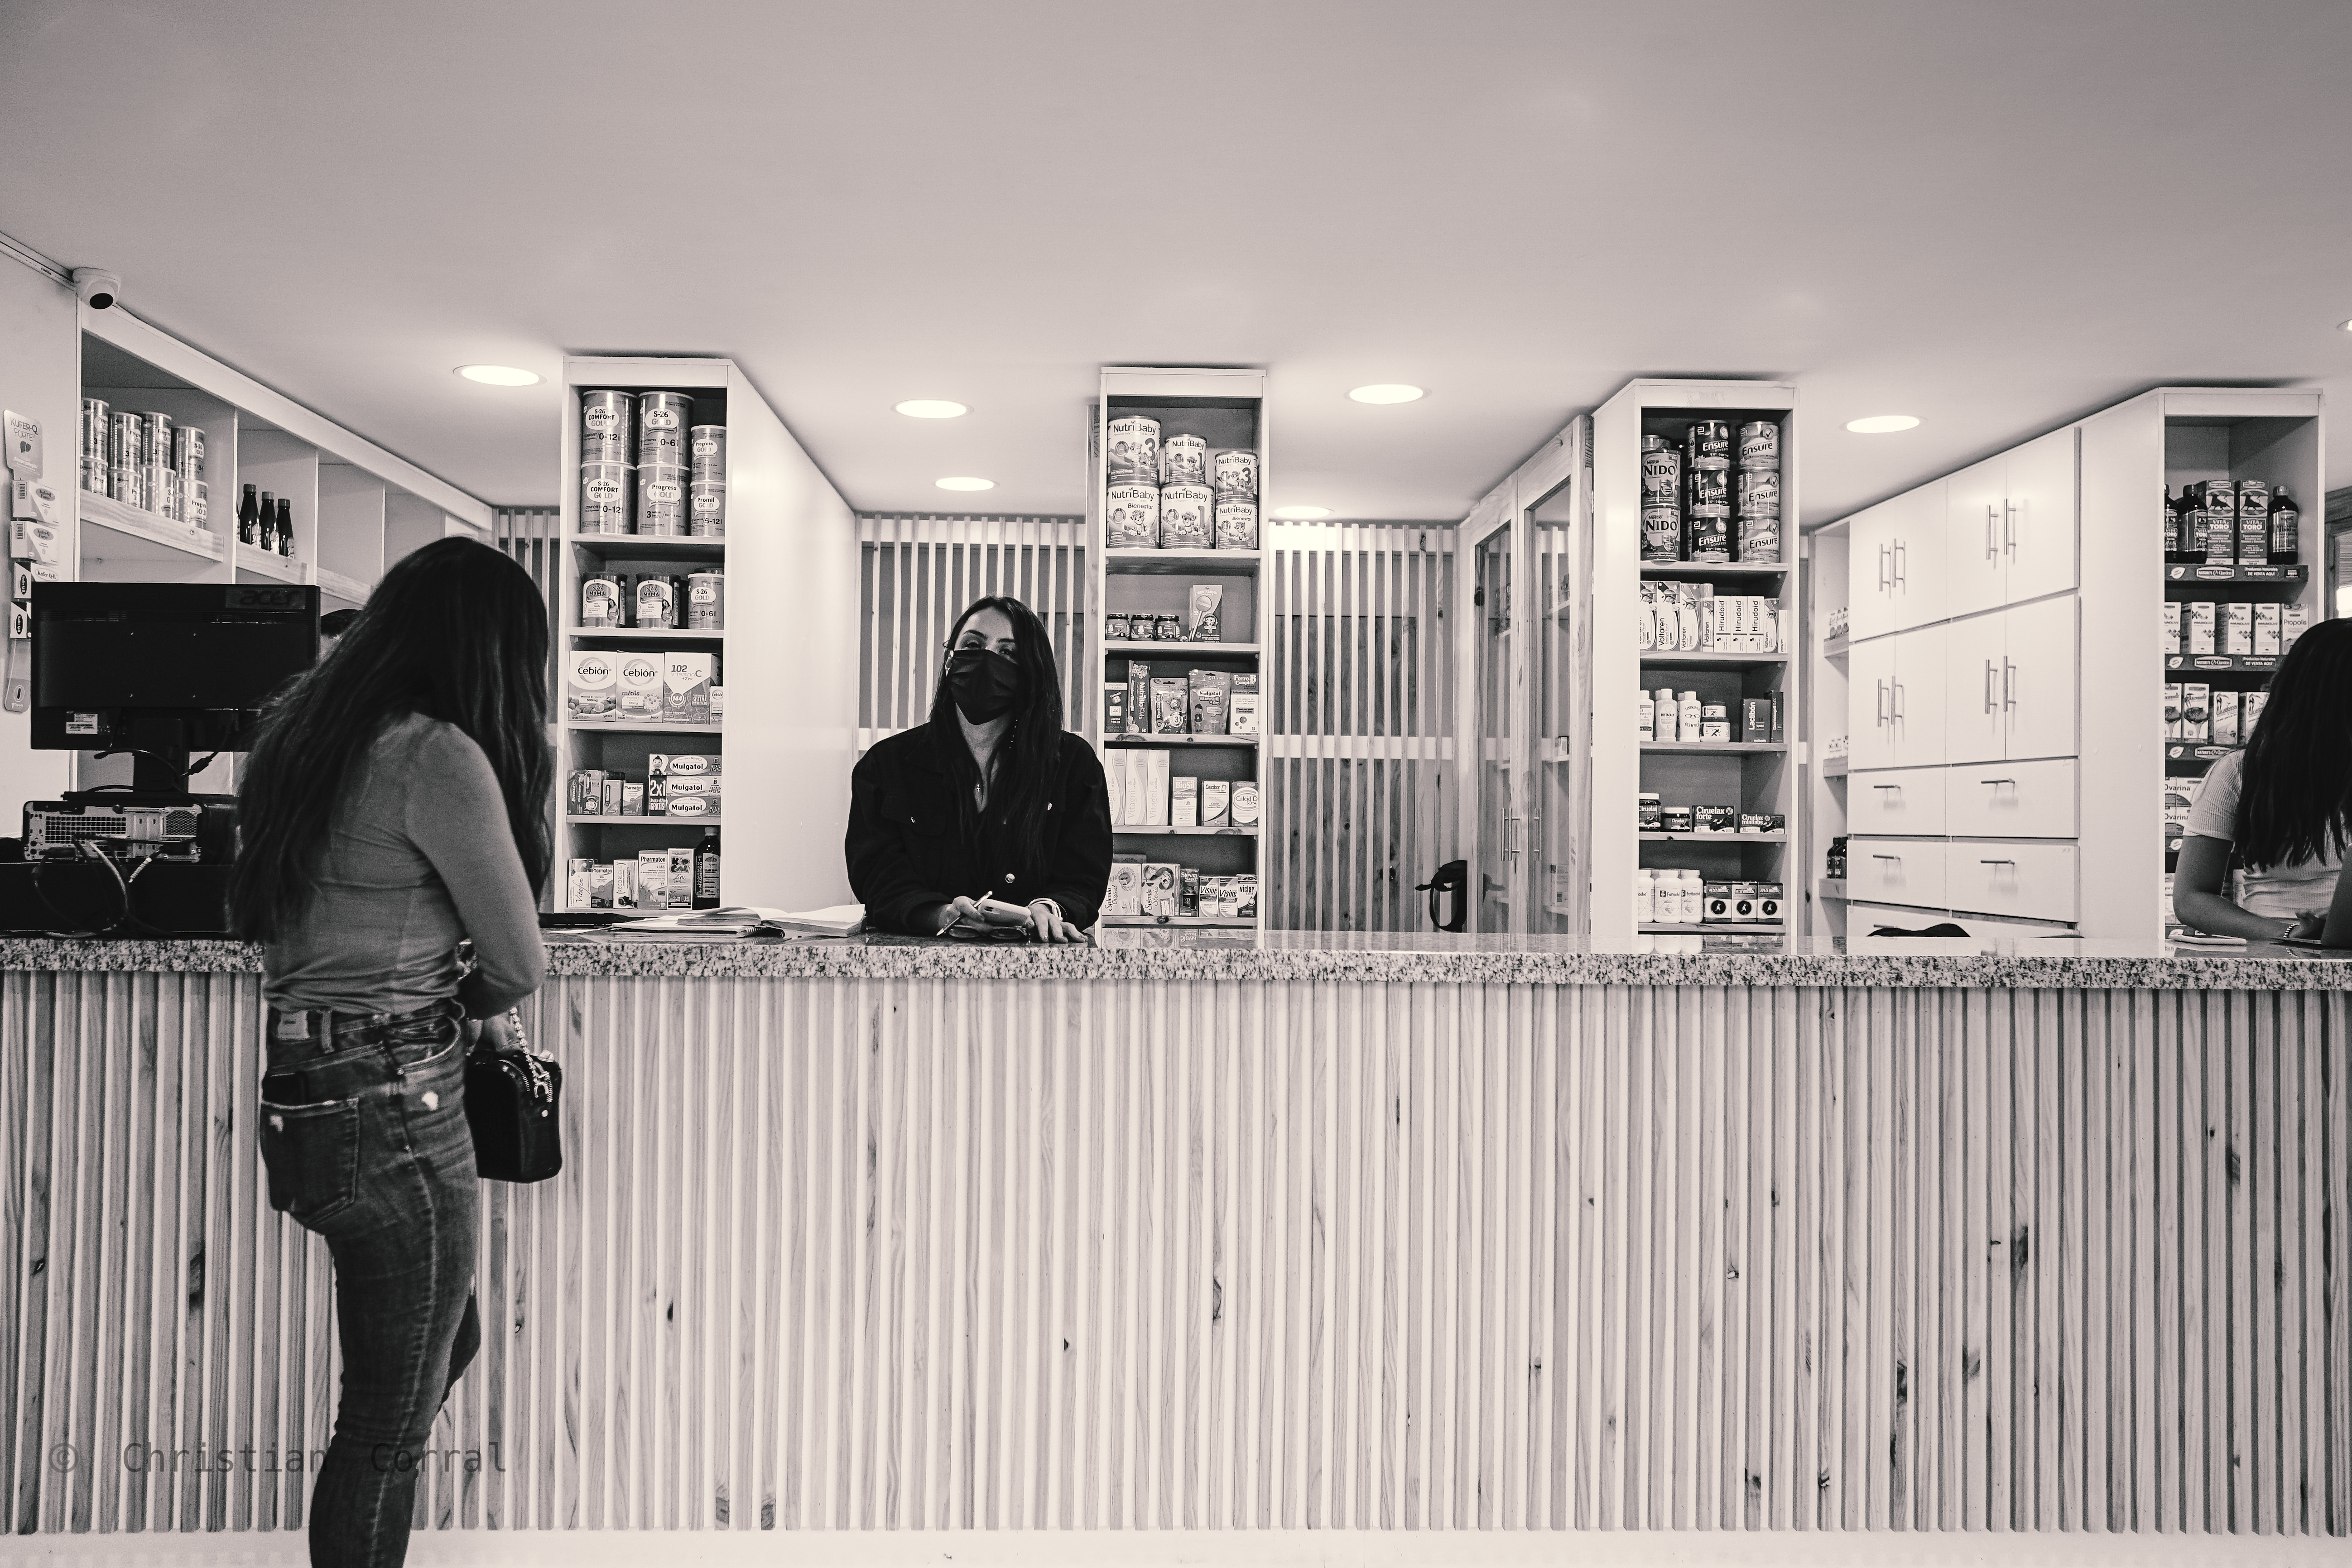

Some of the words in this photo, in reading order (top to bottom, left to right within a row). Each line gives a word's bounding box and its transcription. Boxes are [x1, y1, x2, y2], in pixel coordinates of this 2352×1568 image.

[10, 417, 38, 435] KUFER-Q
[1113, 422, 1156, 435] NutriBaby
[14, 428, 33, 441] FORTE
[660, 438, 676, 447] 0-6
[1145, 437, 1156, 460] 3
[1703, 440, 1729, 451] Ensure
[1742, 442, 1773, 456] Ensure
[1219, 456, 1251, 465] NutriBaby
[1242, 467, 1252, 485] 3
[1644, 465, 1676, 477] NIDO
[1111, 489, 1154, 502] NutriBaby
[1165, 490, 1208, 502] NutriBaby
[1700, 487, 1727, 499] Ensure
[1749, 490, 1778, 502] Ensure
[646, 510, 651, 518] 3
[1220, 506, 1252, 515] NutriBaby
[1645, 519, 1677, 532] NIDO
[1698, 535, 1727, 547] Ensure
[1749, 537, 1778, 549] Ensure
[240, 590, 300, 605] acer
[578, 667, 609, 675] Cebión
[623, 668, 655, 677] Cebión
[650, 780, 666, 796] 2x1
[649, 802, 666, 810] ¡GRATIS!
[1128, 790, 1137, 819] Vitagni
[1150, 790, 1159, 819] Vitagni
[1696, 806, 1725, 815] Ciruelax
[1181, 872, 1198, 880] Stevia
[1200, 886, 1218, 894] Visine
[1220, 889, 1237, 897] Visine
[1105, 887, 1113, 911] Splenda
